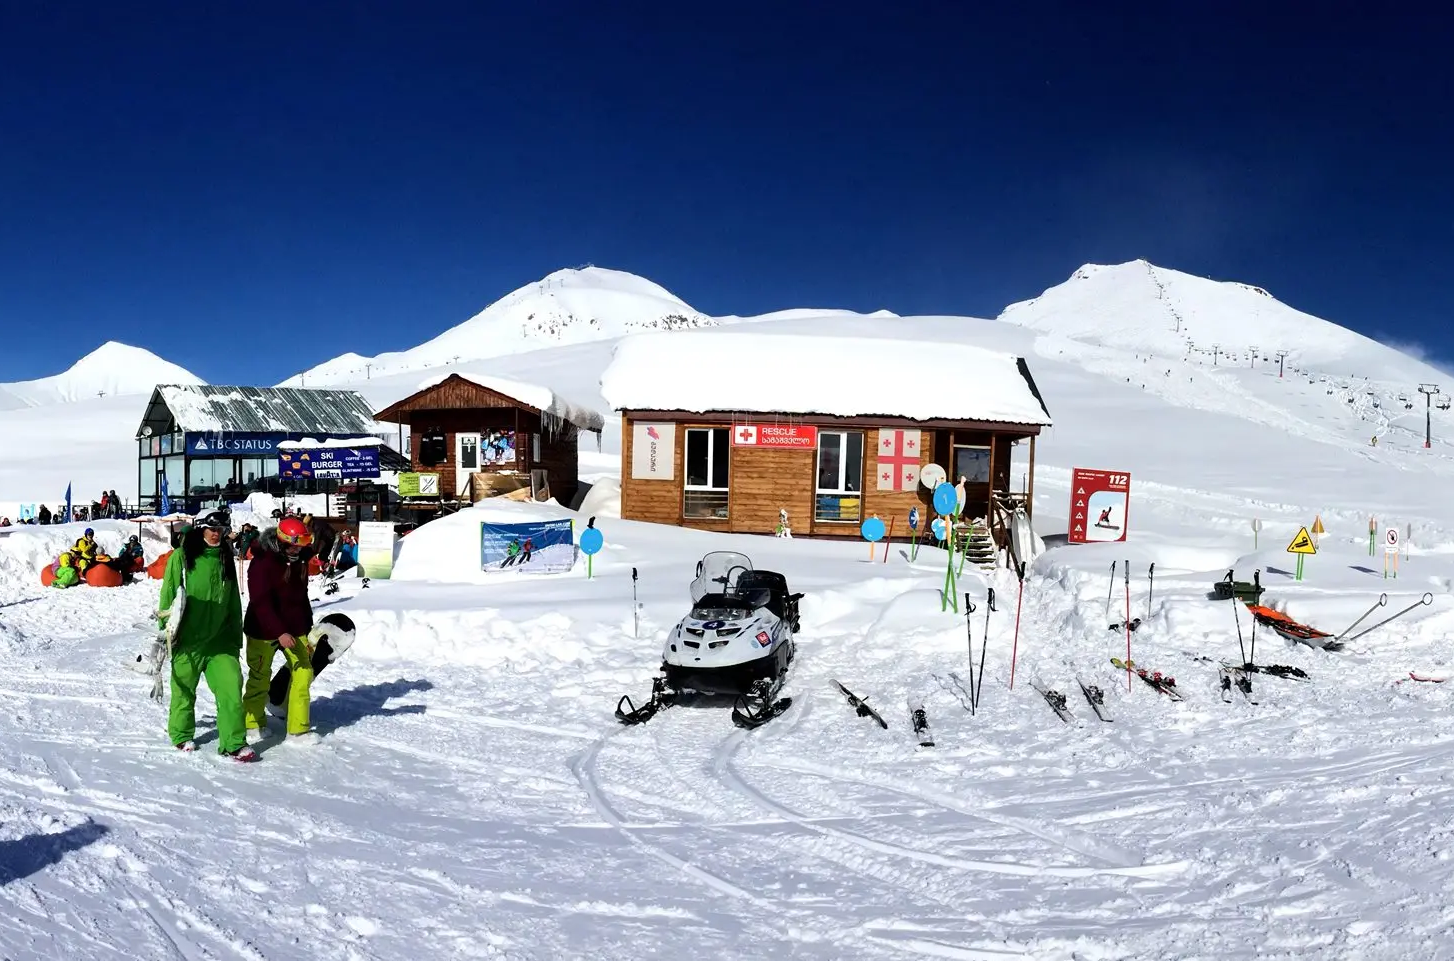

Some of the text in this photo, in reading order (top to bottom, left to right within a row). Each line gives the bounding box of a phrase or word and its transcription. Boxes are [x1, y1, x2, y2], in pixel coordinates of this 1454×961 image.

[762, 427, 797, 435] RESCUE
[210, 439, 272, 450] TBC STATUS
[320, 452, 334, 460] SKI
[311, 461, 343, 469] BURGER
[1108, 474, 1128, 485] 112
